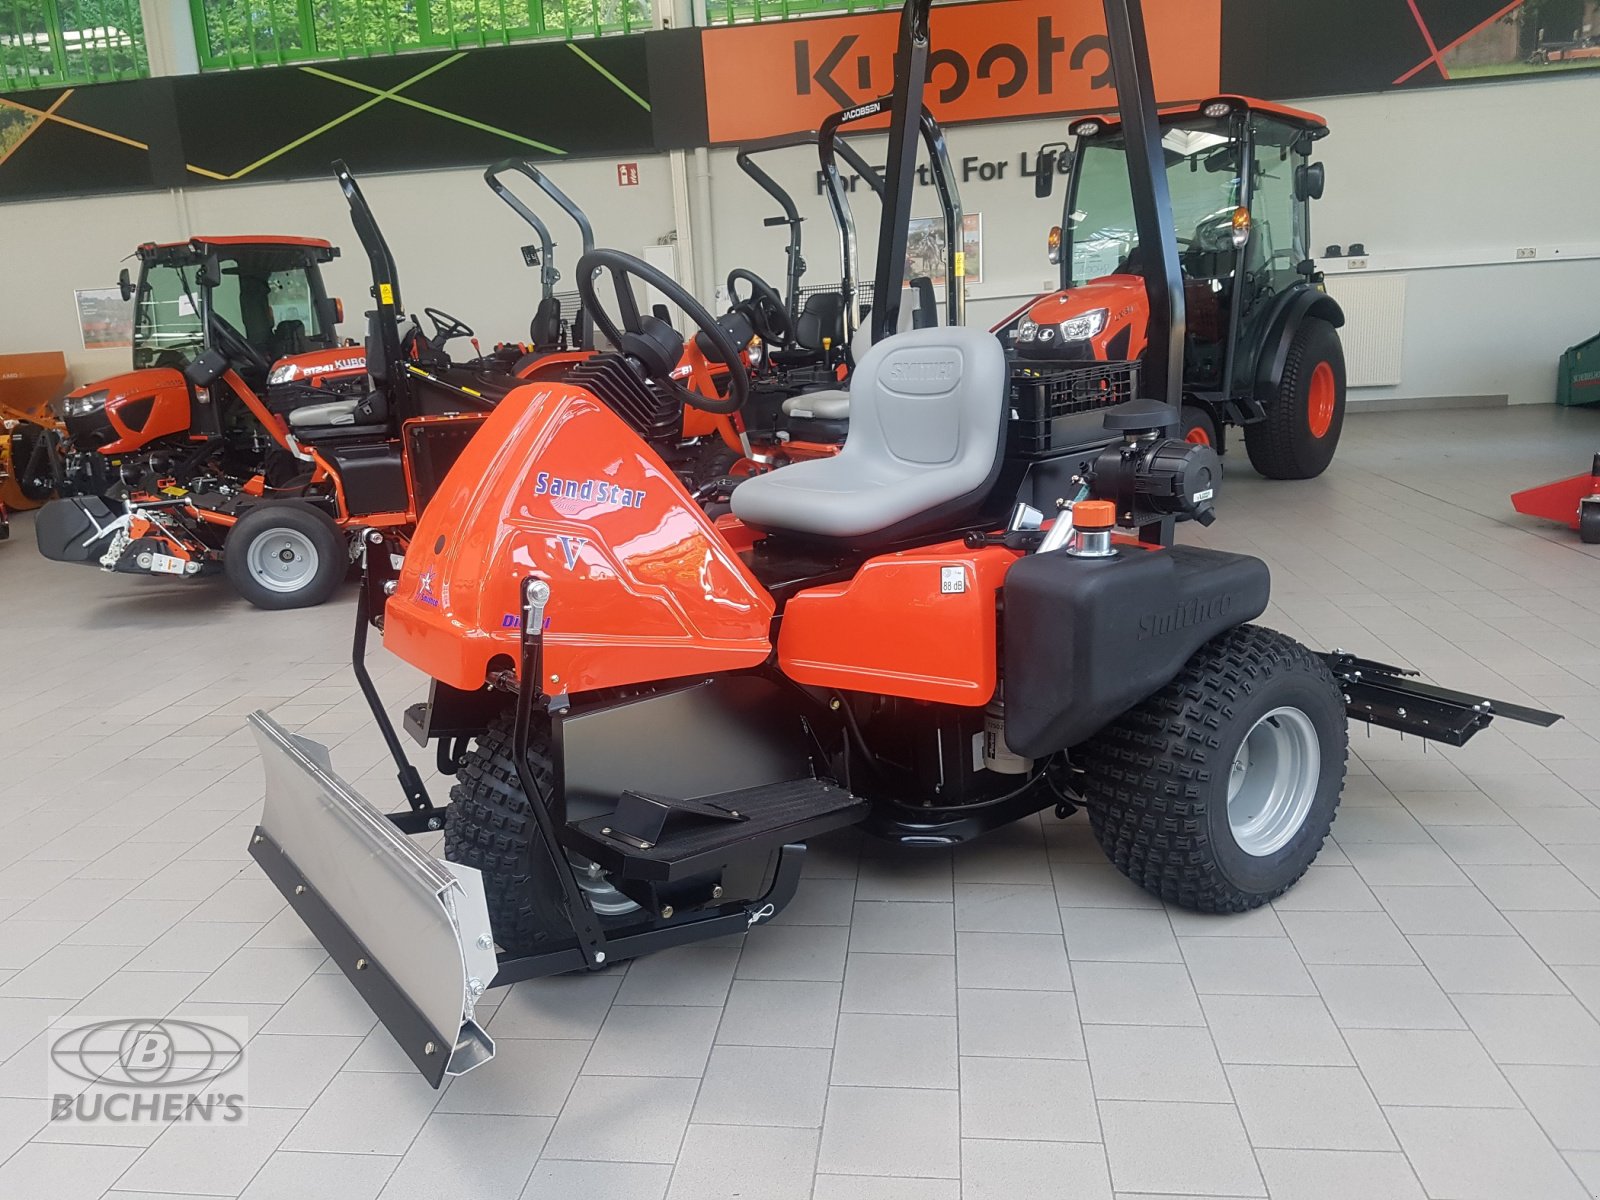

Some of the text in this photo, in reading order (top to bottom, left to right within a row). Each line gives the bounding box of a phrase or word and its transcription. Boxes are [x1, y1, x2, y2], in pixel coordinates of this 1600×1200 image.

[842, 102, 881, 121] JACOBSEN
[962, 155, 1008, 182] For
[1020, 149, 1073, 177] Lfe
[534, 471, 647, 508] Sand Star
[556, 535, 588, 571] V
[943, 580, 963, 591] 88 dB
